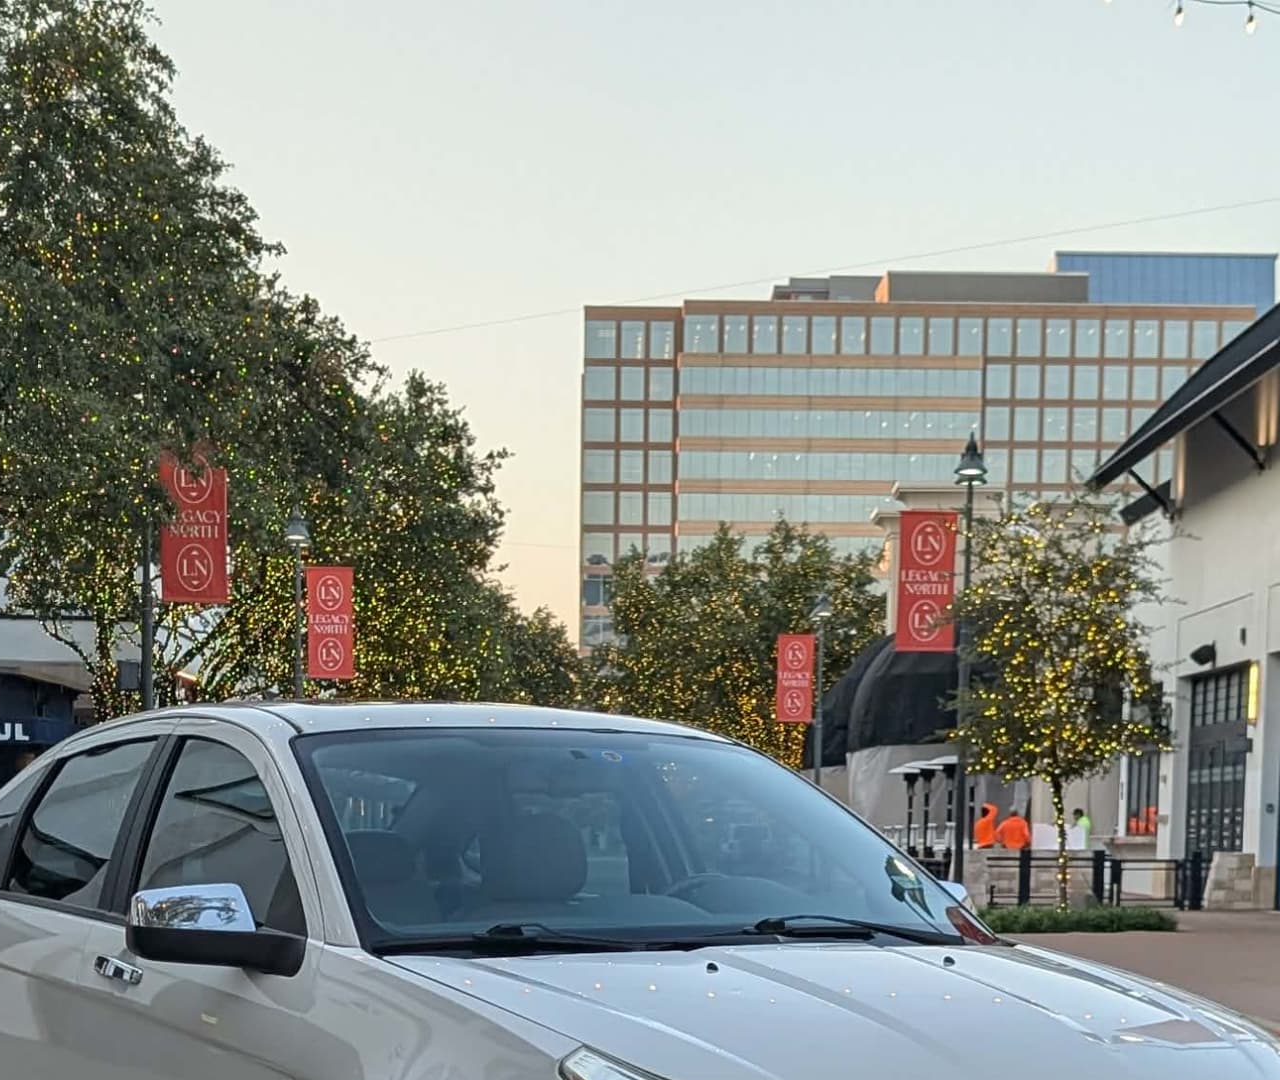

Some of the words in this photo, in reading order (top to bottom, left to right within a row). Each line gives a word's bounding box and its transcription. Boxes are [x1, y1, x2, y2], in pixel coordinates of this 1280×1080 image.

[170, 525, 219, 539] NORTH
[917, 535, 940, 551] LN
[182, 559, 208, 576] LN
[321, 586, 340, 600] LN
[904, 583, 949, 595] NORTH
[310, 614, 349, 623] LEGACY
[314, 624, 348, 634] NORTH
